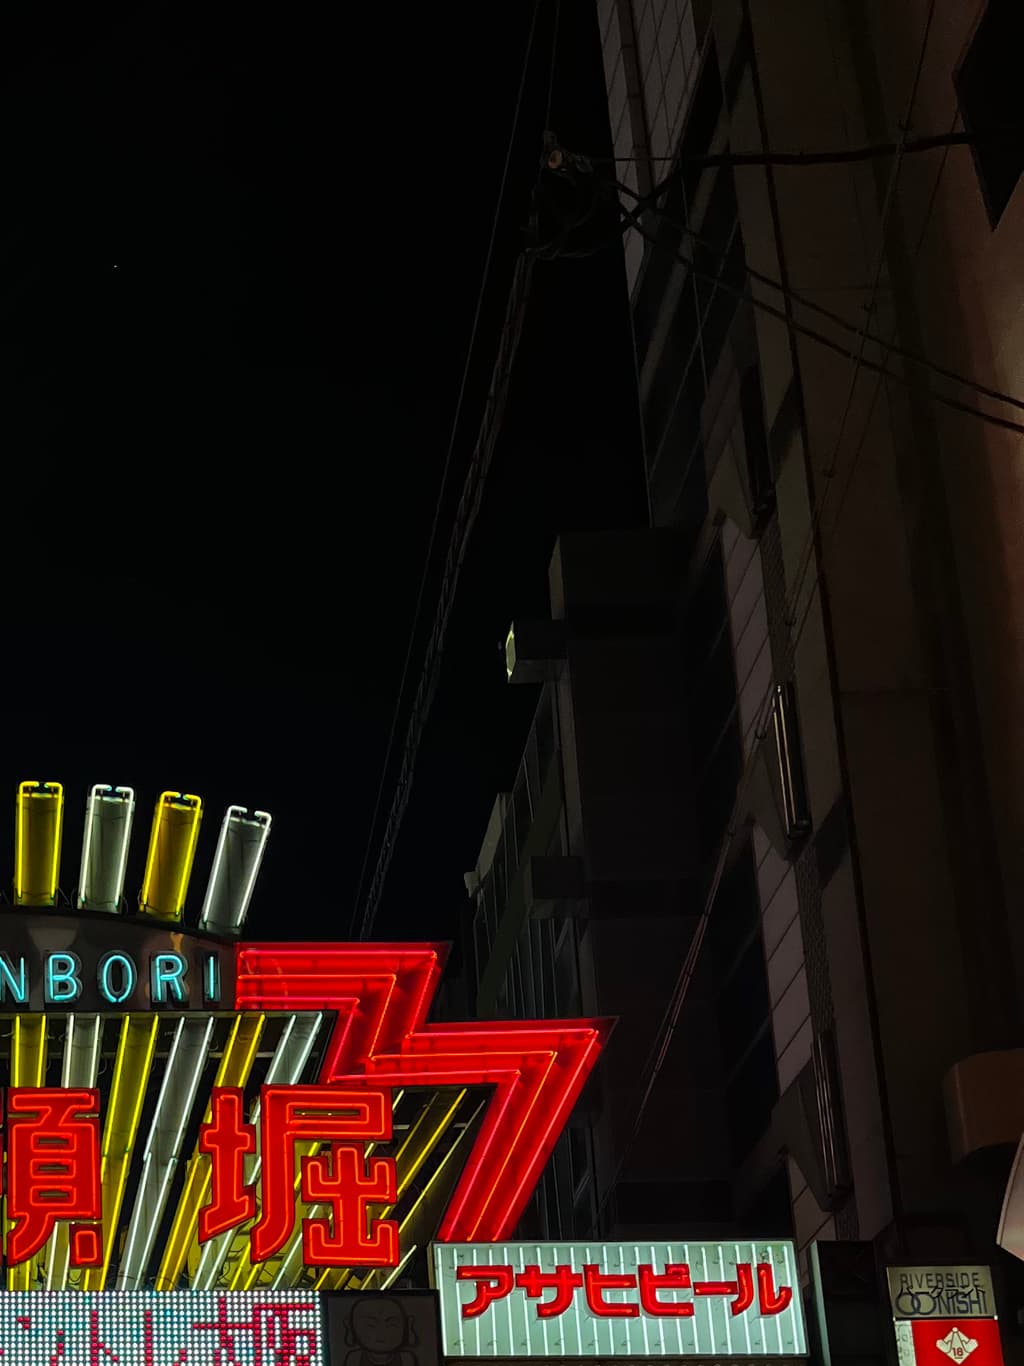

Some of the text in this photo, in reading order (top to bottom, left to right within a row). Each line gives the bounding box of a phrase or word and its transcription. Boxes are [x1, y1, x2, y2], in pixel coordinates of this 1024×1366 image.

[455, 1262, 794, 1319] アサヒビール
